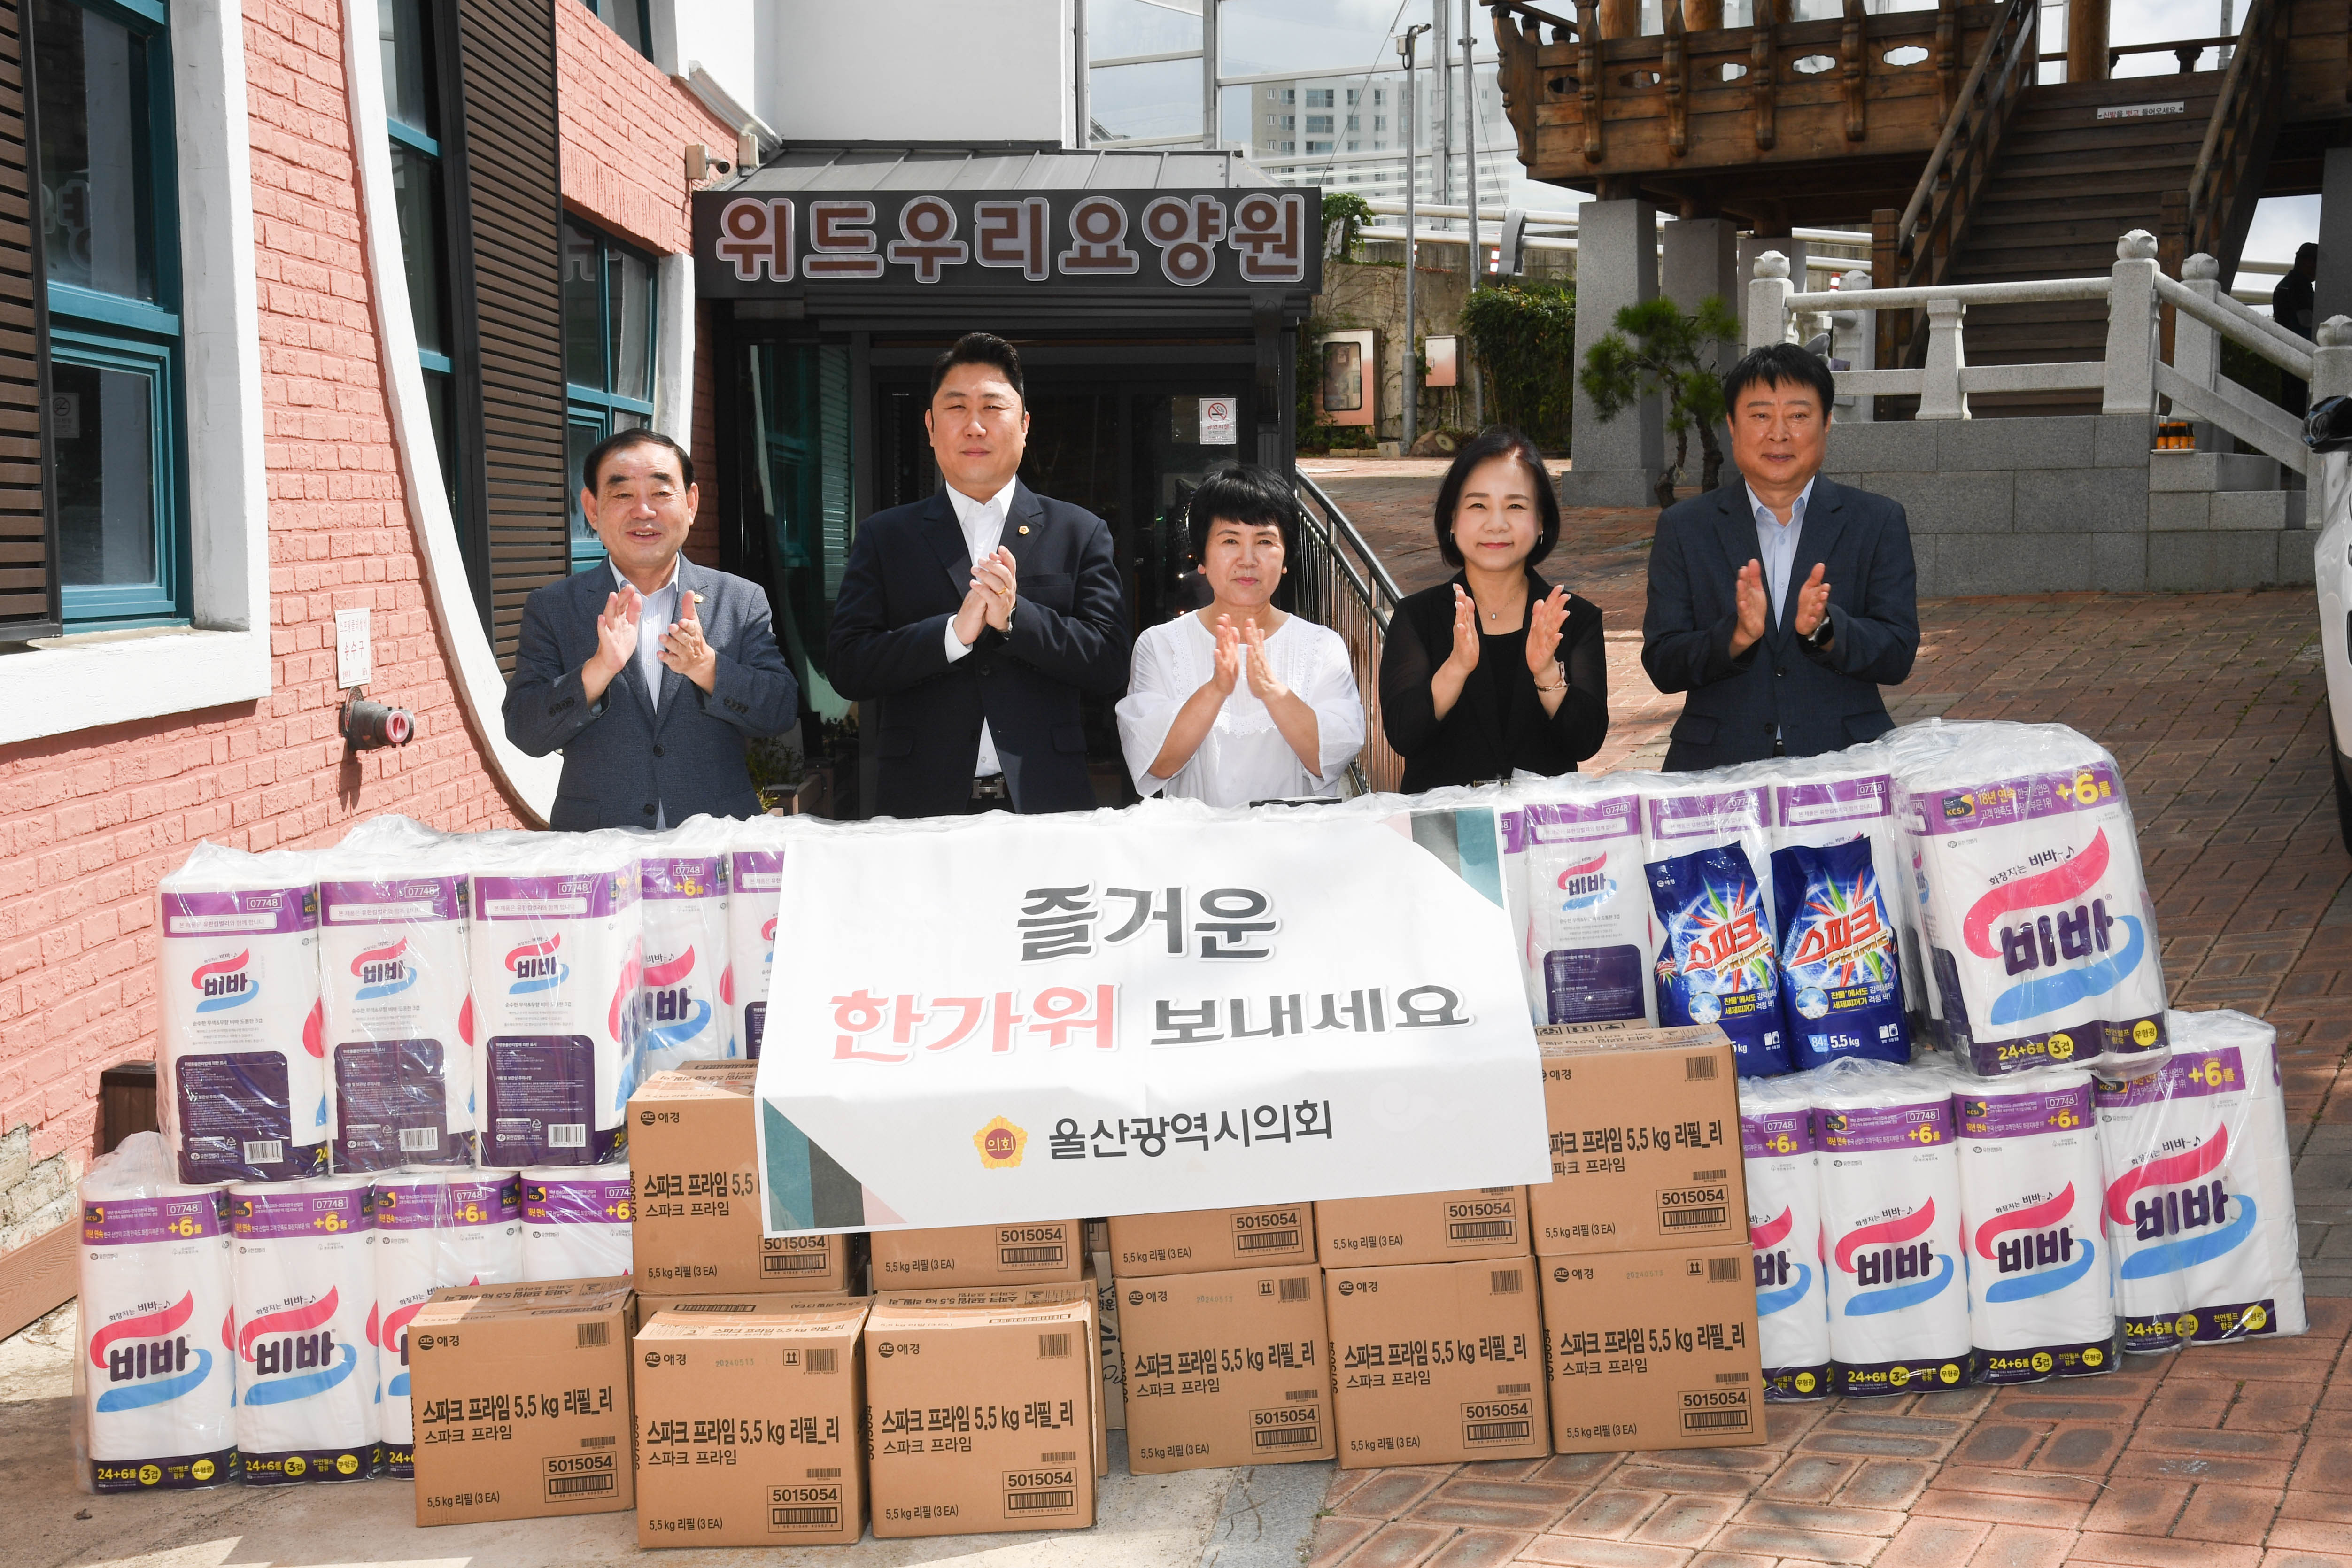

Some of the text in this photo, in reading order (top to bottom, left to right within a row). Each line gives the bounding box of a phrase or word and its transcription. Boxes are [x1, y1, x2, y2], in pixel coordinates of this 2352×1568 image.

[721, 197, 1300, 283] 위드우리요양원
[344, 641, 364, 661] 송수구
[1978, 791, 1996, 804] 18년
[1998, 788, 2016, 803] 연속
[2056, 774, 2112, 804] +6롤
[1606, 804, 1628, 814] 07748
[1946, 807, 1965, 816] KCSI
[1981, 797, 2053, 820] 고객 만족도 1위
[676, 865, 701, 875] 07748
[1988, 865, 2027, 885] 화장지는
[408, 886, 435, 896] 07748
[562, 883, 588, 893] 07748
[1569, 873, 1606, 896] 비바
[250, 898, 278, 908] 07748
[1858, 894, 1873, 907] 프라임
[1739, 905, 1755, 916] 프라임
[1017, 883, 1277, 961] 즐거운
[1787, 899, 1881, 968] 스파크
[2000, 899, 2113, 976] 비바
[1682, 910, 1763, 974] 스파크
[1827, 929, 1889, 969] PRIME
[1716, 937, 1772, 978] PRIME
[205, 973, 248, 996] 비바
[1833, 997, 1868, 1009] 세제찌꺼기
[1868, 995, 1882, 1004] 걱정
[830, 984, 1470, 1061] 한가위 보내세요
[2135, 1028, 2156, 1039] 무형광
[1830, 1034, 1860, 1049] 5.5 kg
[1997, 1043, 2045, 1060] 24+6롤
[1550, 1069, 1571, 1080] 애경
[2188, 1062, 2235, 1087] +6롤
[2050, 1097, 2075, 1107] 07748
[658, 1112, 679, 1123] 애경
[1910, 1111, 1935, 1121] 07748
[1049, 1100, 1333, 1160] 울산광역시의회
[1767, 1121, 1794, 1130] 07748
[1583, 1127, 1622, 1153] 프라임
[1627, 1128, 1648, 1151] 5.5
[1653, 1127, 1670, 1151] kg
[1675, 1120, 1722, 1148] 리필_리
[988, 1137, 1014, 1152] 의회
[644, 1172, 753, 1198] 스파크 프라임 5.5
[457, 1190, 482, 1199] 07748
[1663, 1189, 1724, 1205] 5015054
[170, 1204, 198, 1214] 07748
[317, 1200, 344, 1209] 07748
[1450, 1202, 1511, 1217] 5015054
[1996, 1200, 2020, 1213] 화장지는
[2135, 1180, 2229, 1241] 비바
[1237, 1213, 1297, 1228] 5015054
[1855, 1215, 1880, 1227] 화장지는
[1002, 1228, 1062, 1242] 5015054
[764, 1236, 825, 1250] 5015054
[1997, 1227, 2074, 1274] 비바
[1857, 1242, 1933, 1287] 비바
[1572, 1268, 1593, 1279] 애경
[1357, 1282, 1377, 1292] 애경
[1146, 1291, 1167, 1302] 애경
[109, 1309, 136, 1322] 화장지는
[256, 1303, 282, 1316] 화장지는
[437, 1336, 459, 1347] 애경
[1561, 1322, 1745, 1357] 스파크 프라임 5.5 kg 리필_리
[257, 1332, 335, 1376] 비바
[897, 1344, 919, 1355] 애경
[109, 1338, 190, 1383] 비바
[664, 1354, 686, 1365] 애경
[1135, 1340, 1314, 1378] 스파크 프라임 5.5 kg 리필_리
[423, 1386, 612, 1424] 스파크 프라임 5.5 kg 리필_리
[1684, 1392, 1746, 1406] 5015054
[882, 1400, 1073, 1435] 스파크 프라임 5.5 kg 리필_리
[1255, 1409, 1315, 1425] 5015054
[1467, 1403, 1528, 1418] 5015054
[425, 1425, 511, 1444] 스파크 프라임
[647, 1416, 839, 1446] 스파크 프라임 5.5 kg 리필_리
[287, 1462, 304, 1473] 3겹
[549, 1456, 612, 1472] 5015054
[142, 1468, 158, 1480] 3겹
[1009, 1472, 1073, 1487] 5015054
[428, 1497, 440, 1507] 5.5
[442, 1497, 453, 1507] kg
[456, 1493, 472, 1506] 리필
[773, 1488, 837, 1501] 5015054
